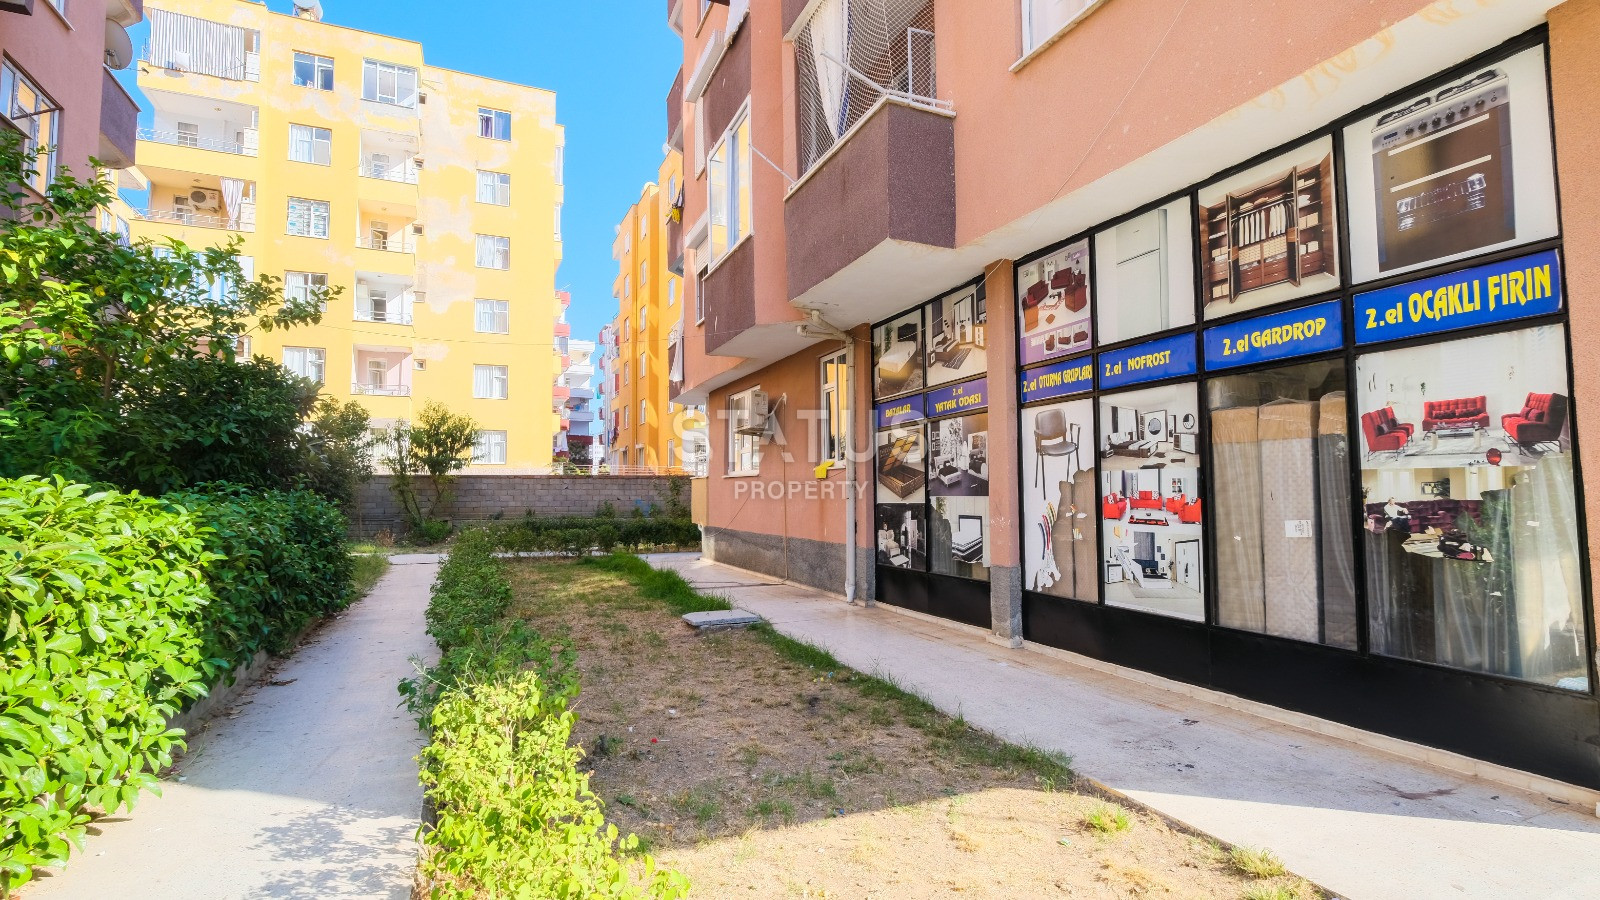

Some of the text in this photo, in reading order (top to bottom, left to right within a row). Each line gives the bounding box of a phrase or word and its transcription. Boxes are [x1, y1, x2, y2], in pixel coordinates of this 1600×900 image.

[1365, 302, 1403, 329] 2.el
[1487, 264, 1552, 311] FIRIN
[1222, 317, 1327, 356] 2.el GARDROP
[1105, 350, 1171, 377] 2.el NOFROST
[952, 386, 963, 396] 2.el
[1023, 378, 1037, 392] 2.el
[1038, 371, 1062, 388] OTURMA
[885, 403, 912, 418] BAZALAR
[934, 392, 982, 413] YATAK ODASI
